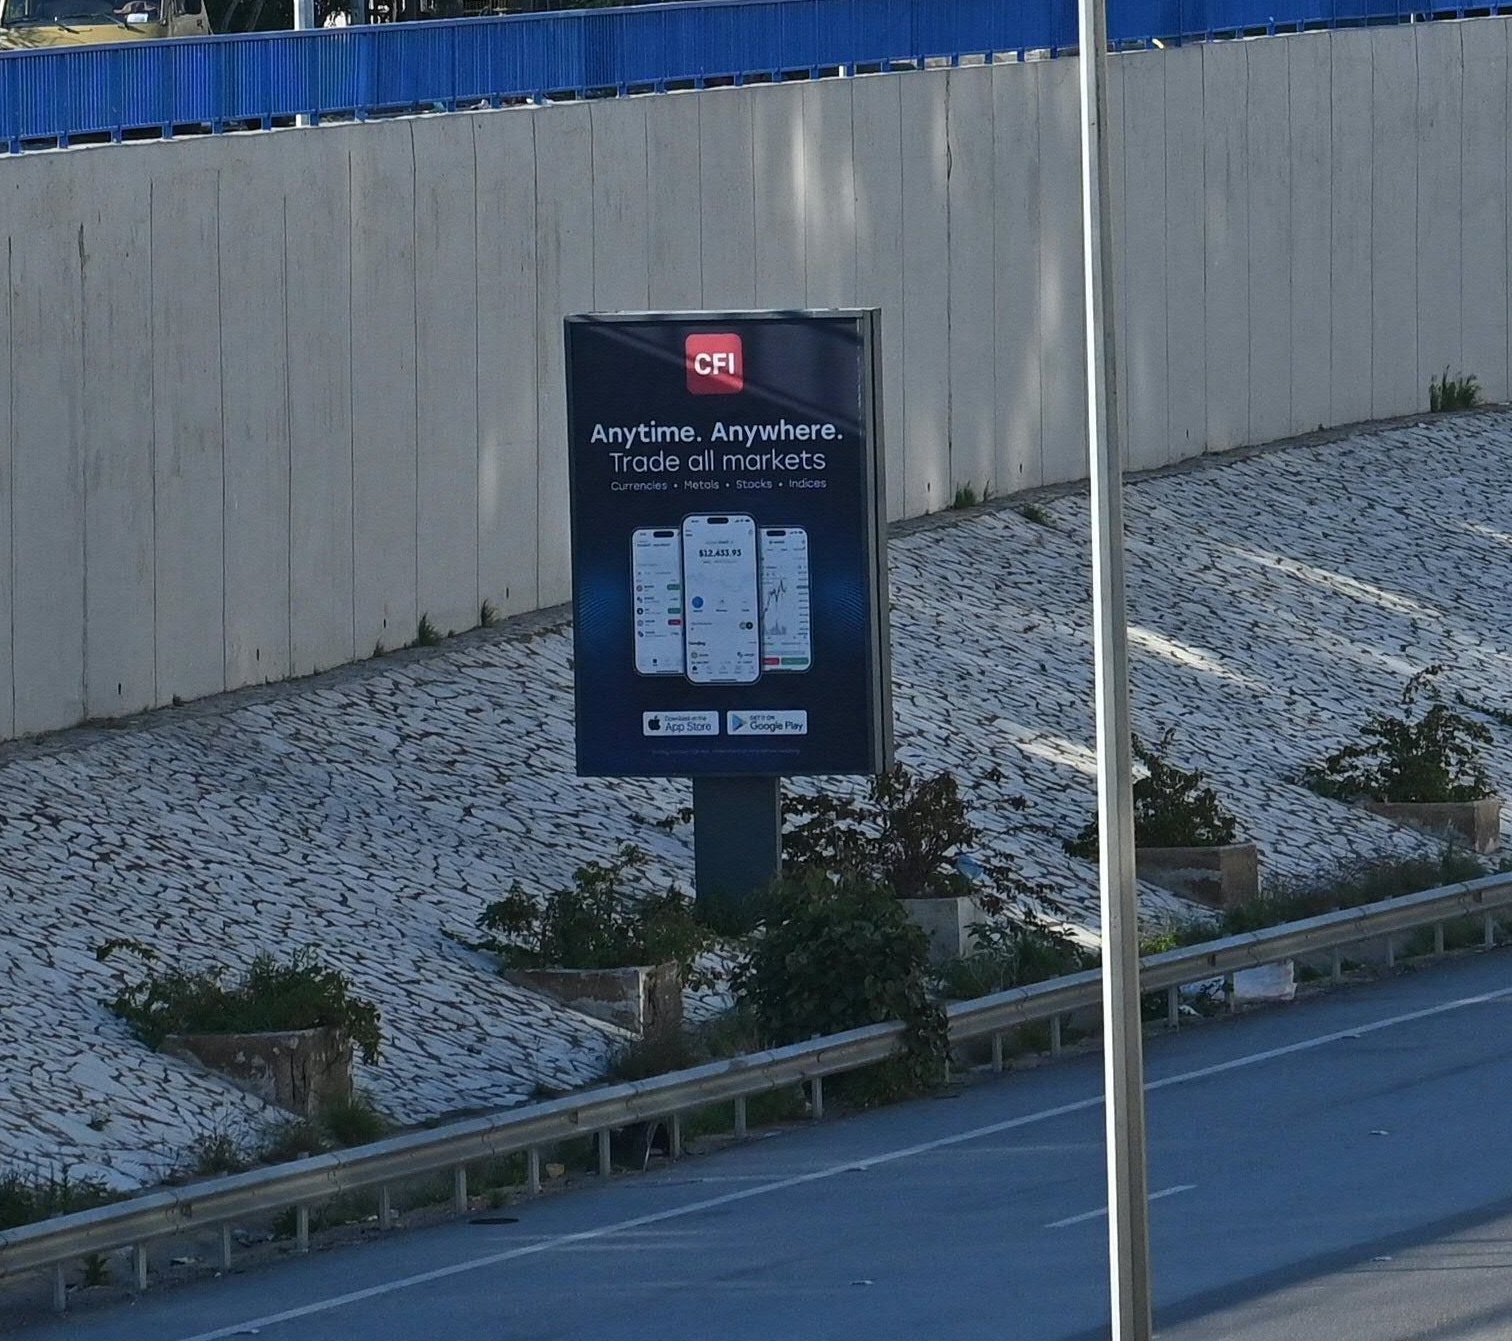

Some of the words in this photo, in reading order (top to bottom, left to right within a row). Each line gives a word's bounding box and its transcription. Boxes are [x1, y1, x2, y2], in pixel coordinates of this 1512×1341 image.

[694, 352, 736, 376] CFI
[590, 420, 703, 449] Anytime.
[711, 419, 844, 448] Anywhere.
[609, 450, 680, 473] Trade
[688, 449, 714, 472] all
[723, 448, 826, 471] markets
[610, 481, 668, 491] Currencies
[684, 479, 720, 490] Metals
[736, 479, 773, 489] Stocks
[789, 478, 827, 489] Indices
[665, 722, 684, 732] App
[687, 721, 712, 731] Store
[750, 721, 783, 732] Google
[785, 720, 804, 731] Play
